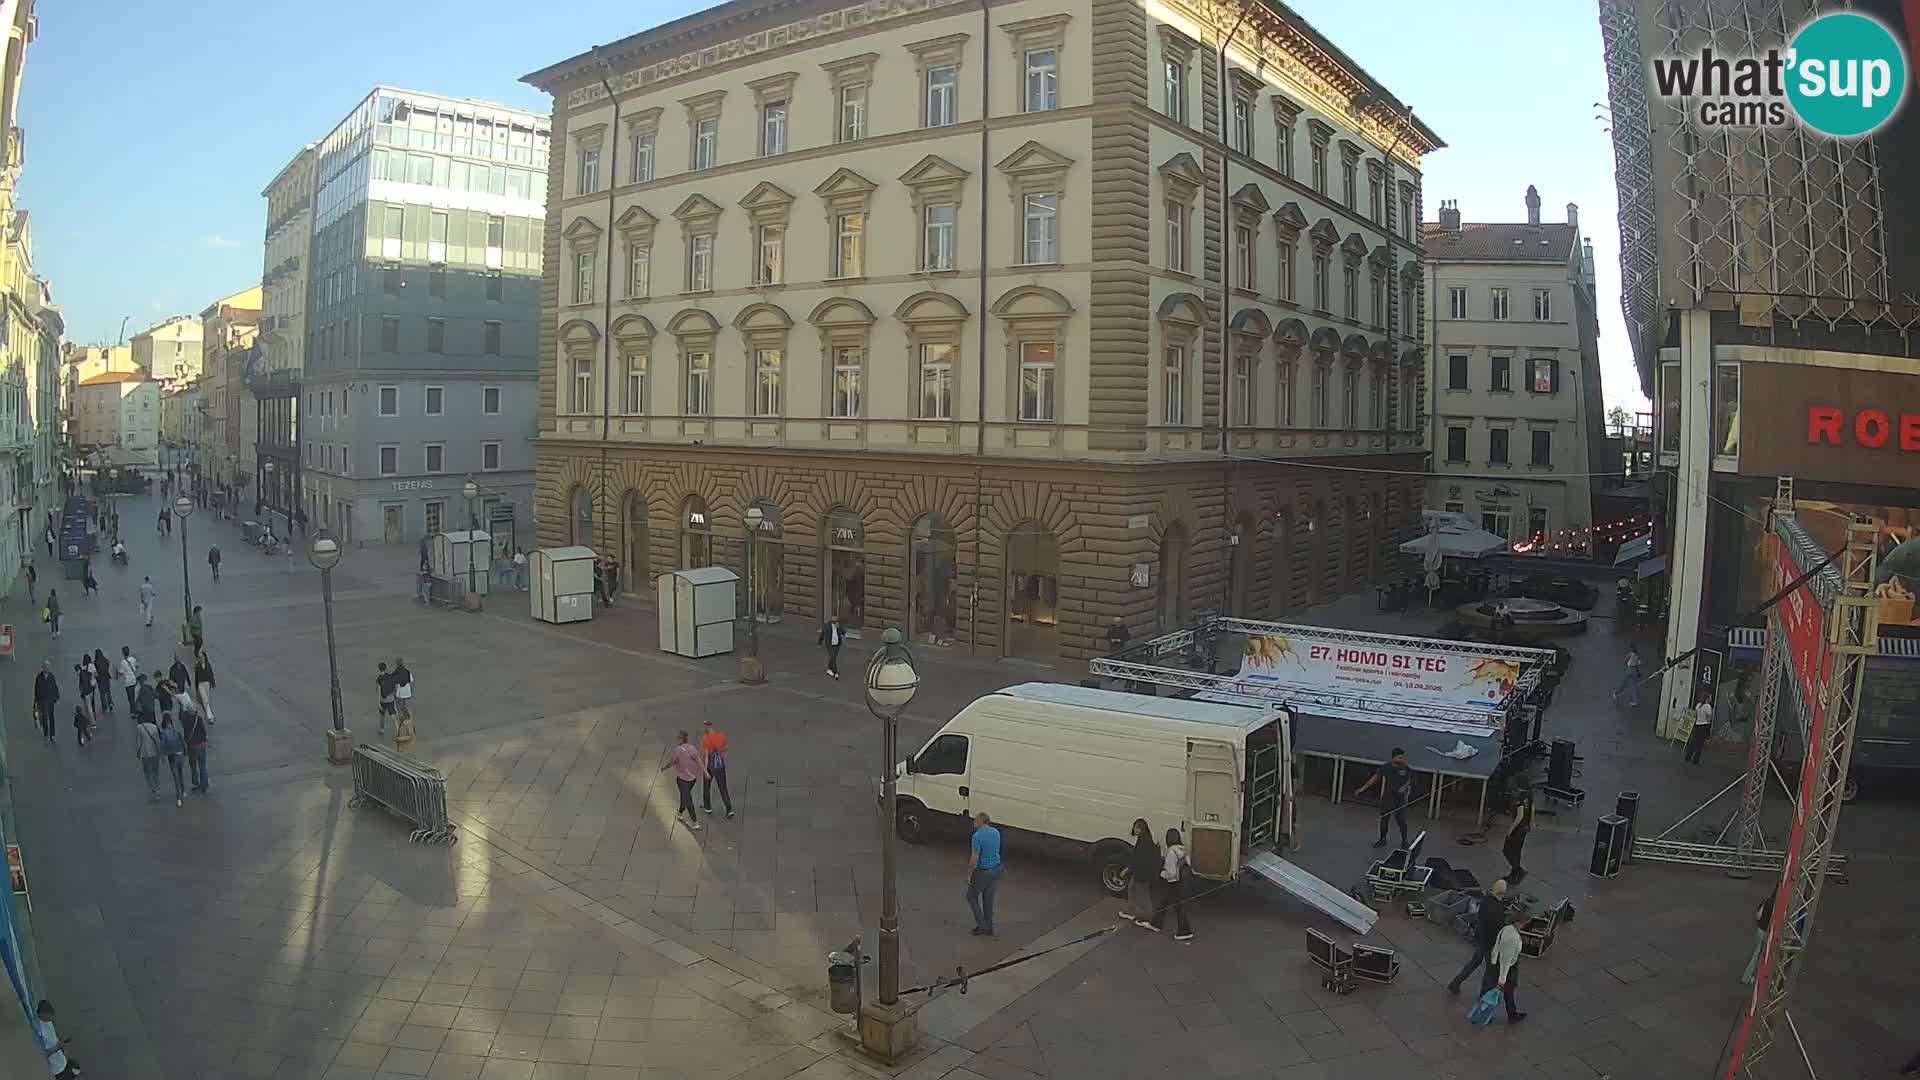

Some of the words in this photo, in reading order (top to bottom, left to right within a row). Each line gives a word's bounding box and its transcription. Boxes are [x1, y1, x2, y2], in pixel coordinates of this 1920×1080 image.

[391, 479, 433, 491] TEZENIS
[1310, 645, 1332, 661] 27.
[1336, 648, 1388, 667] HOMO
[1392, 654, 1412, 670] SI
[1415, 656, 1447, 673] TEĆ
